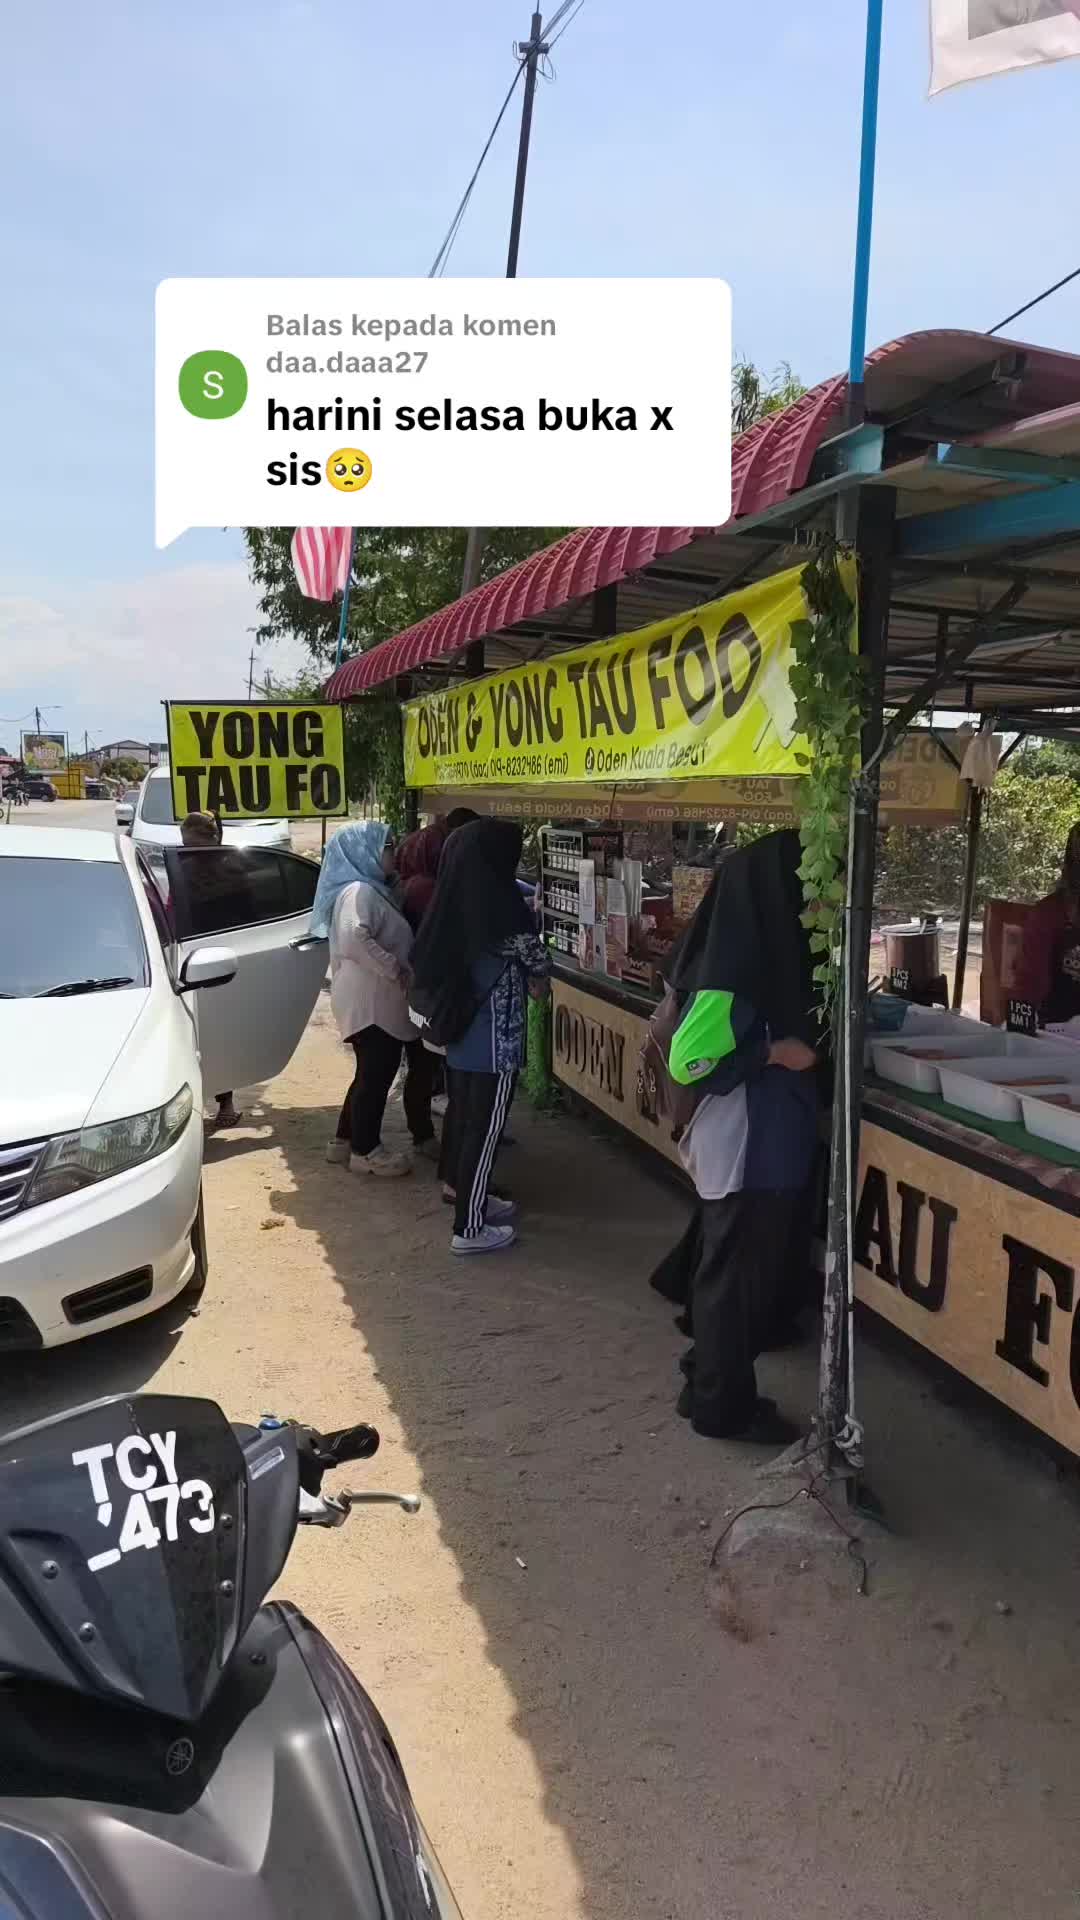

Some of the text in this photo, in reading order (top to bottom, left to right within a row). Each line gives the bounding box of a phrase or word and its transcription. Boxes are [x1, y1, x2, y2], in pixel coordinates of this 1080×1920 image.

[418, 612, 761, 758] ODEN & YONG TAU FOO
[189, 711, 325, 759] YONG
[597, 748, 627, 772] Oden
[630, 744, 665, 770] Kuala
[177, 763, 341, 813] TAU FO
[1016, 1002, 1032, 1016] PCS
[556, 1004, 625, 1102] ODEN
[996, 1233, 1080, 1409] F
[71, 1430, 179, 1504] TCY
